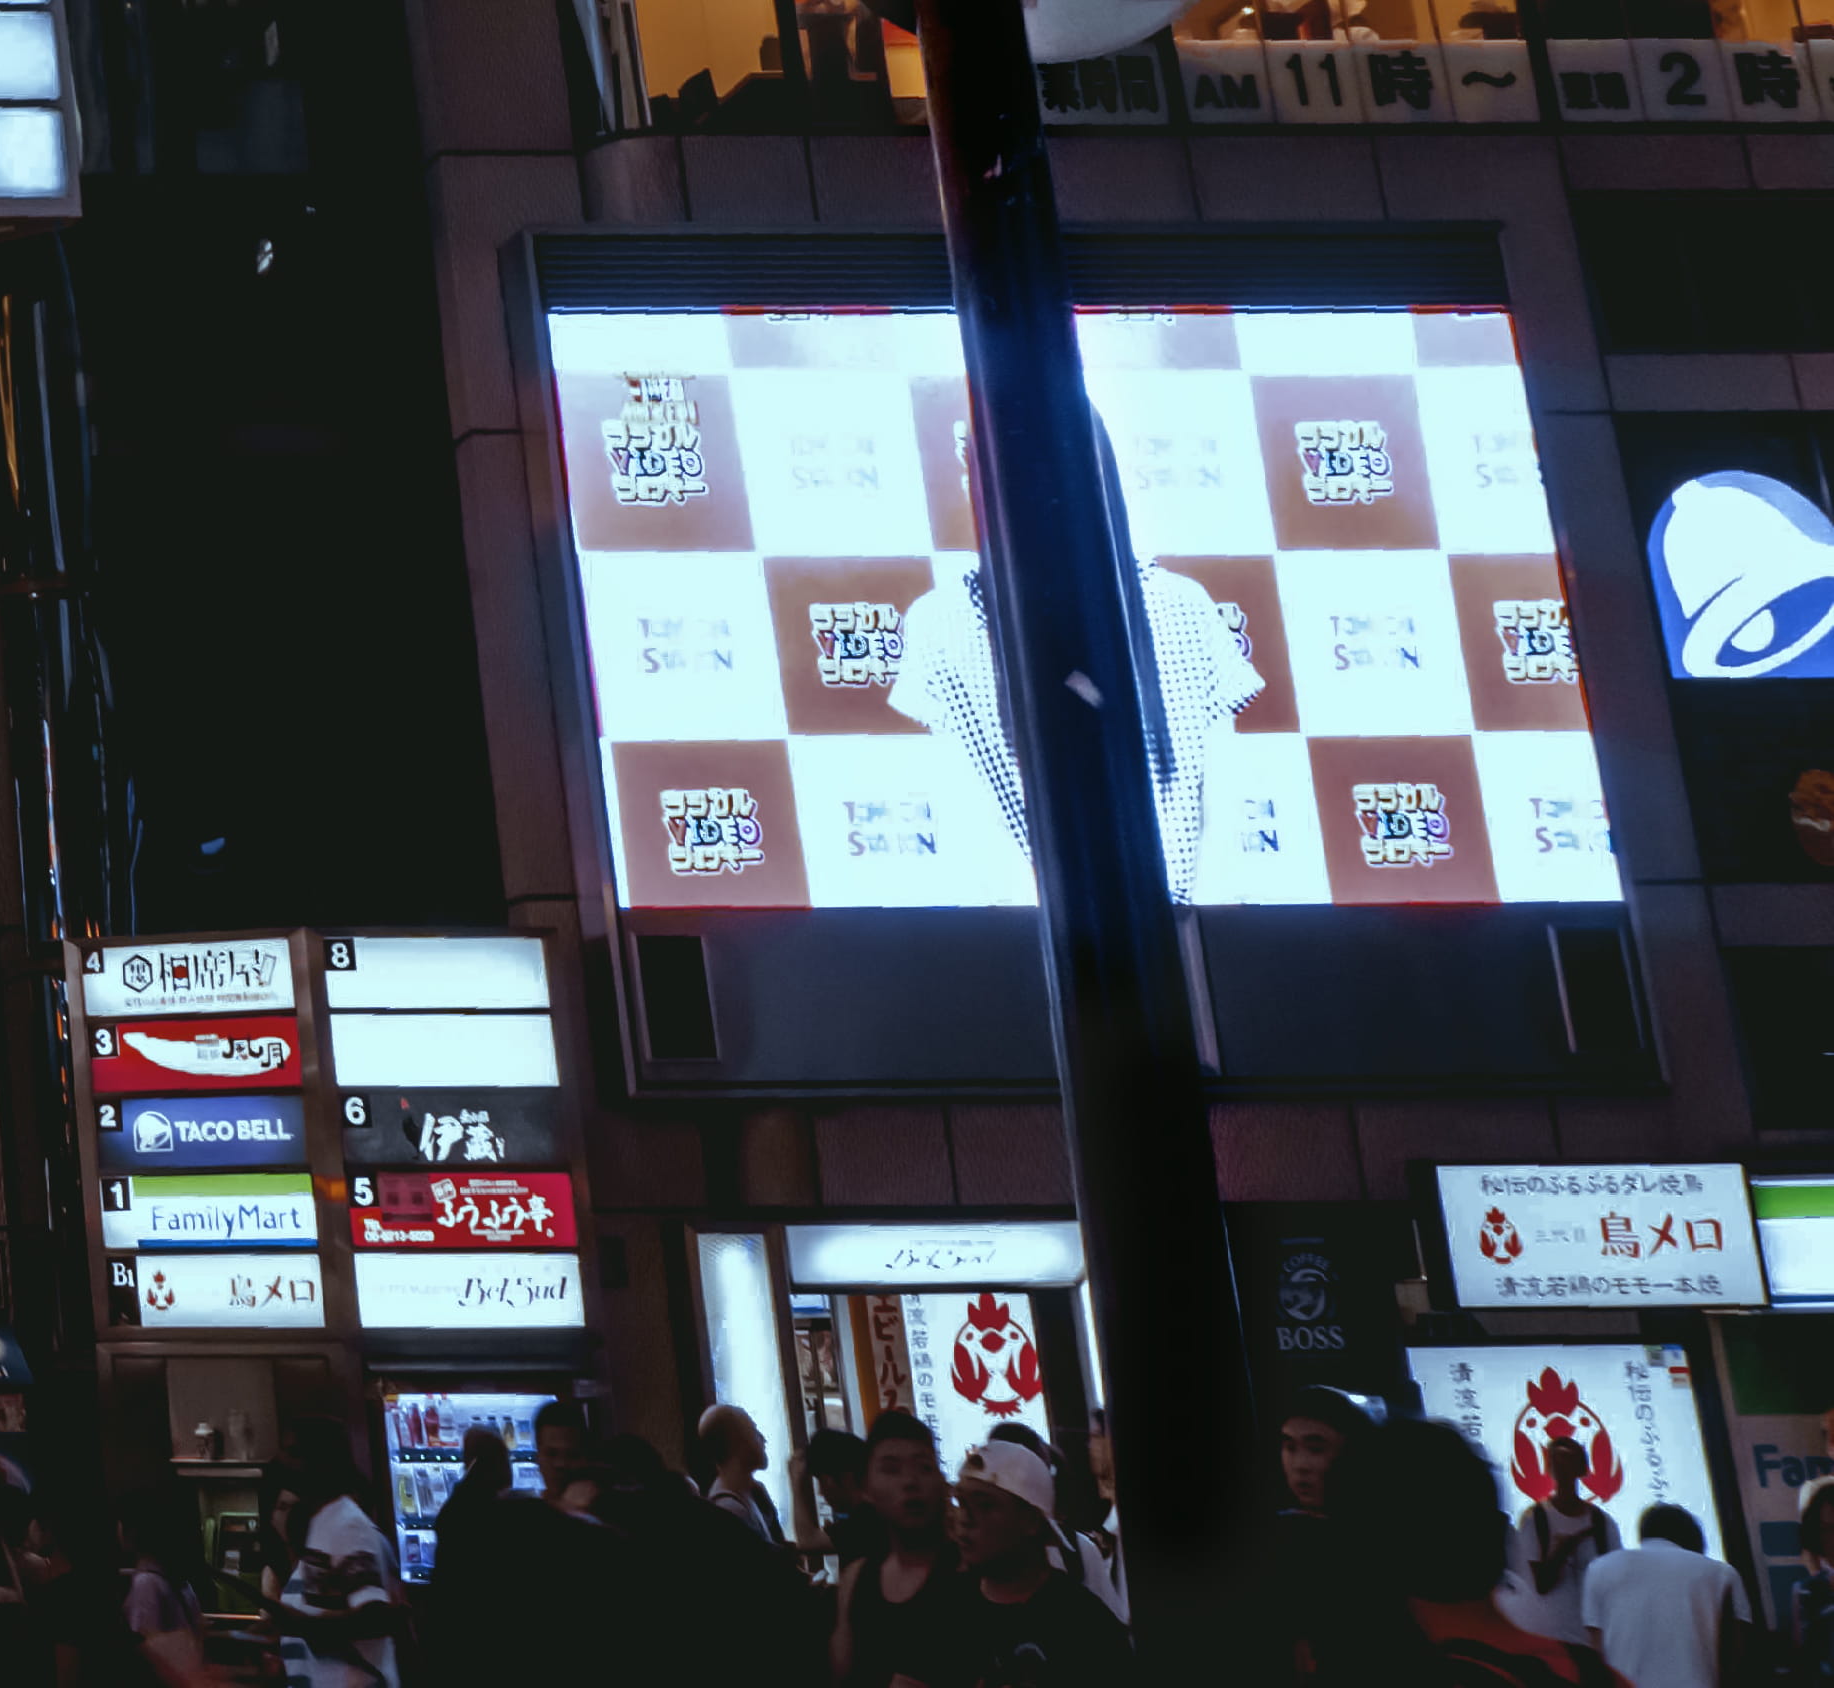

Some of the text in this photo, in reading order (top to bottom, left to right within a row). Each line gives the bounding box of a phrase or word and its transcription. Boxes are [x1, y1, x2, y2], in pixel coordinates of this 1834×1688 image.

[86, 952, 100, 972] 4
[331, 942, 350, 969] 8
[95, 1029, 112, 1055] 3
[99, 1105, 116, 1128] 2
[344, 1096, 366, 1126] 6
[175, 1118, 294, 1143] TACO BELL
[110, 1181, 124, 1209] 1
[354, 1178, 374, 1206] 5
[151, 1204, 302, 1239] FamilyMart
[1600, 1211, 1722, 1259] 鳥メロ
[1275, 1325, 1346, 1351] BOSS
